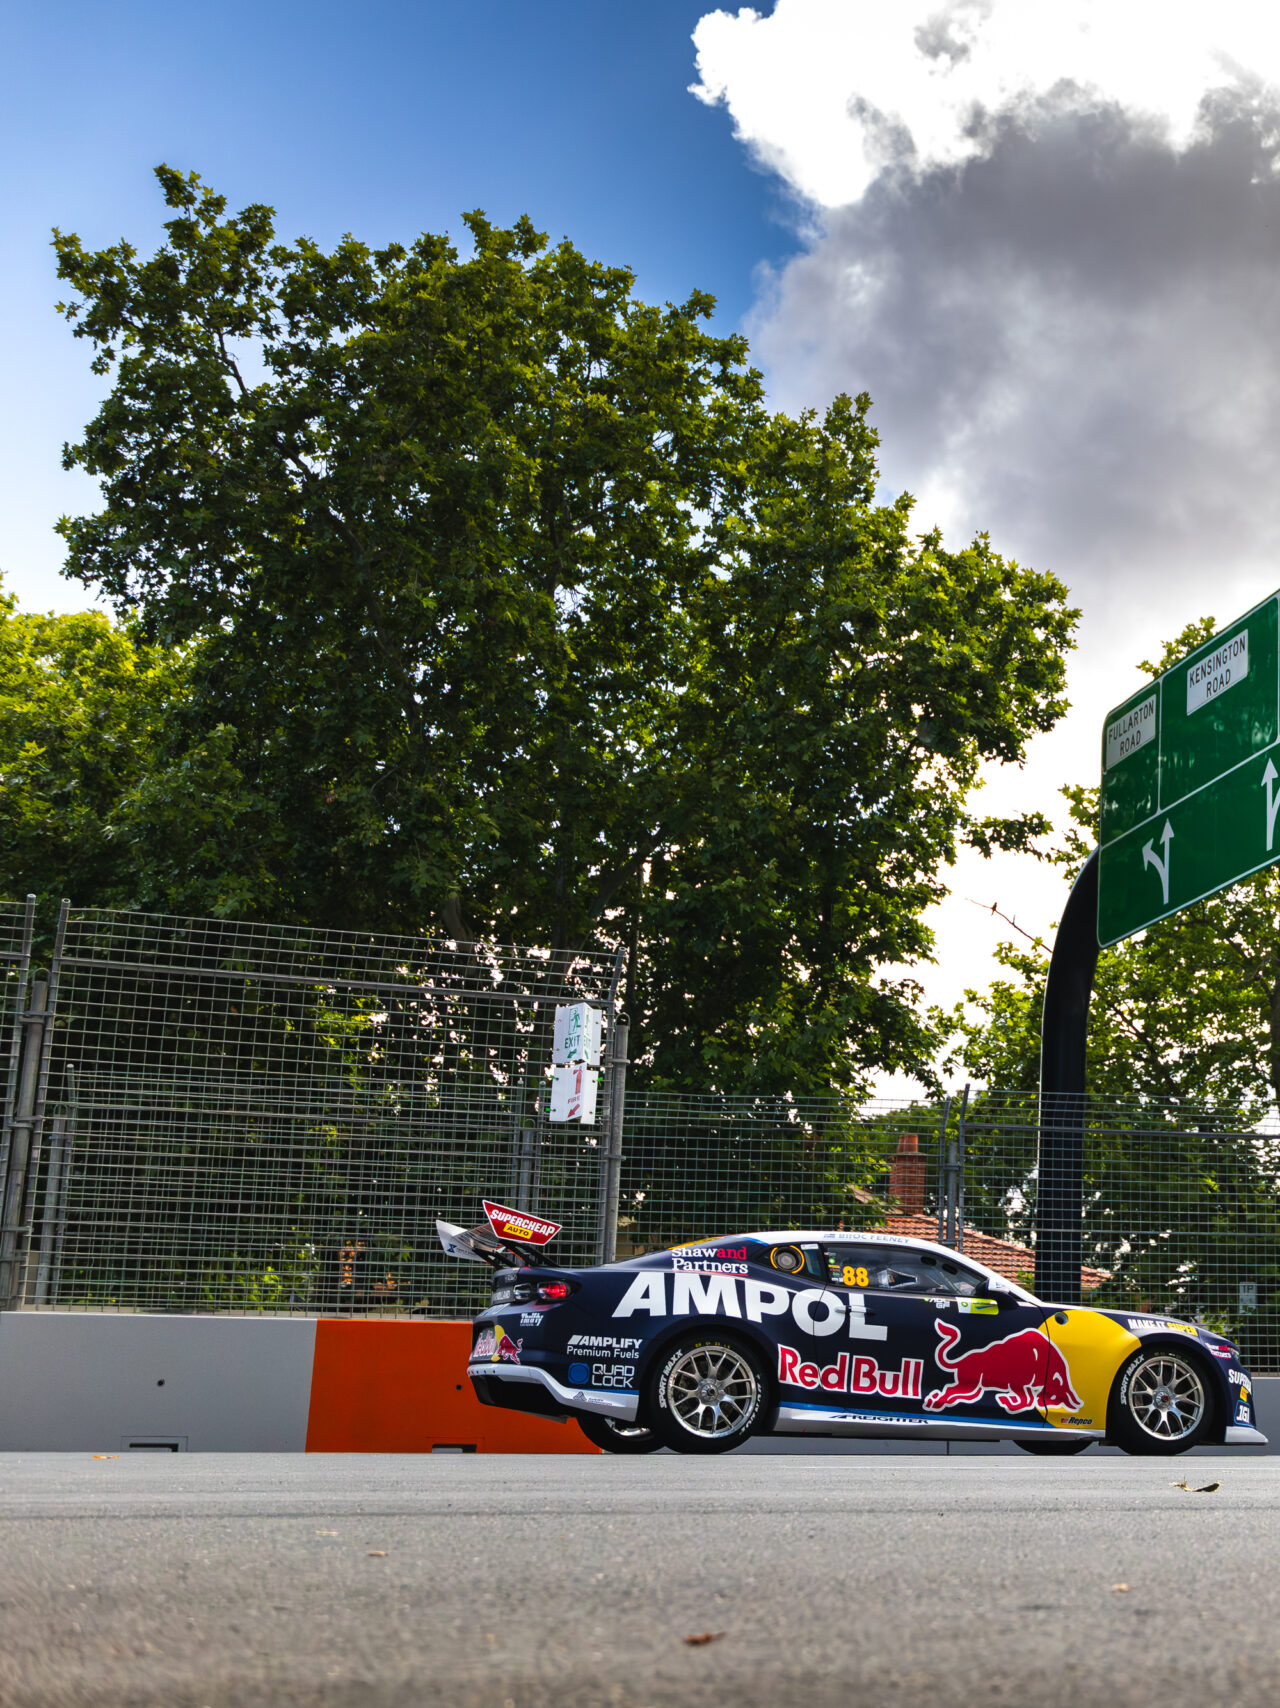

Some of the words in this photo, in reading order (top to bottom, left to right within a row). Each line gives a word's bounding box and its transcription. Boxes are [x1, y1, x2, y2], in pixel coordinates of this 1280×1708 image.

[1189, 636, 1246, 688] KENSINGTON
[1206, 669, 1231, 698] ROAD
[1108, 700, 1154, 744] FULLARTON
[1120, 730, 1142, 757] ROAD
[565, 1035, 581, 1049] EXIT
[490, 1209, 556, 1236] SUPERCHEAP
[507, 1226, 530, 1236] AUTO
[671, 1258, 749, 1274] Partners
[842, 1265, 870, 1287] 88
[611, 1271, 889, 1341] AMPOL
[1127, 1319, 1156, 1330] MAKE
[1156, 1321, 1166, 1329] IT
[1166, 1322, 1199, 1337] SUPER
[567, 1346, 611, 1357] Premium
[613, 1348, 640, 1359] Fuels
[579, 1335, 643, 1349] AMPLIFY
[592, 1363, 635, 1377] QUAD
[662, 1349, 684, 1374] MAXX
[777, 1343, 849, 1392] Red
[850, 1354, 924, 1400] Bull
[591, 1375, 634, 1388] LOCK
[1120, 1375, 1130, 1405] SPORT
[1126, 1354, 1145, 1376] MAXX
[658, 1375, 668, 1408] SPORT
[1068, 1416, 1093, 1426] Repco
